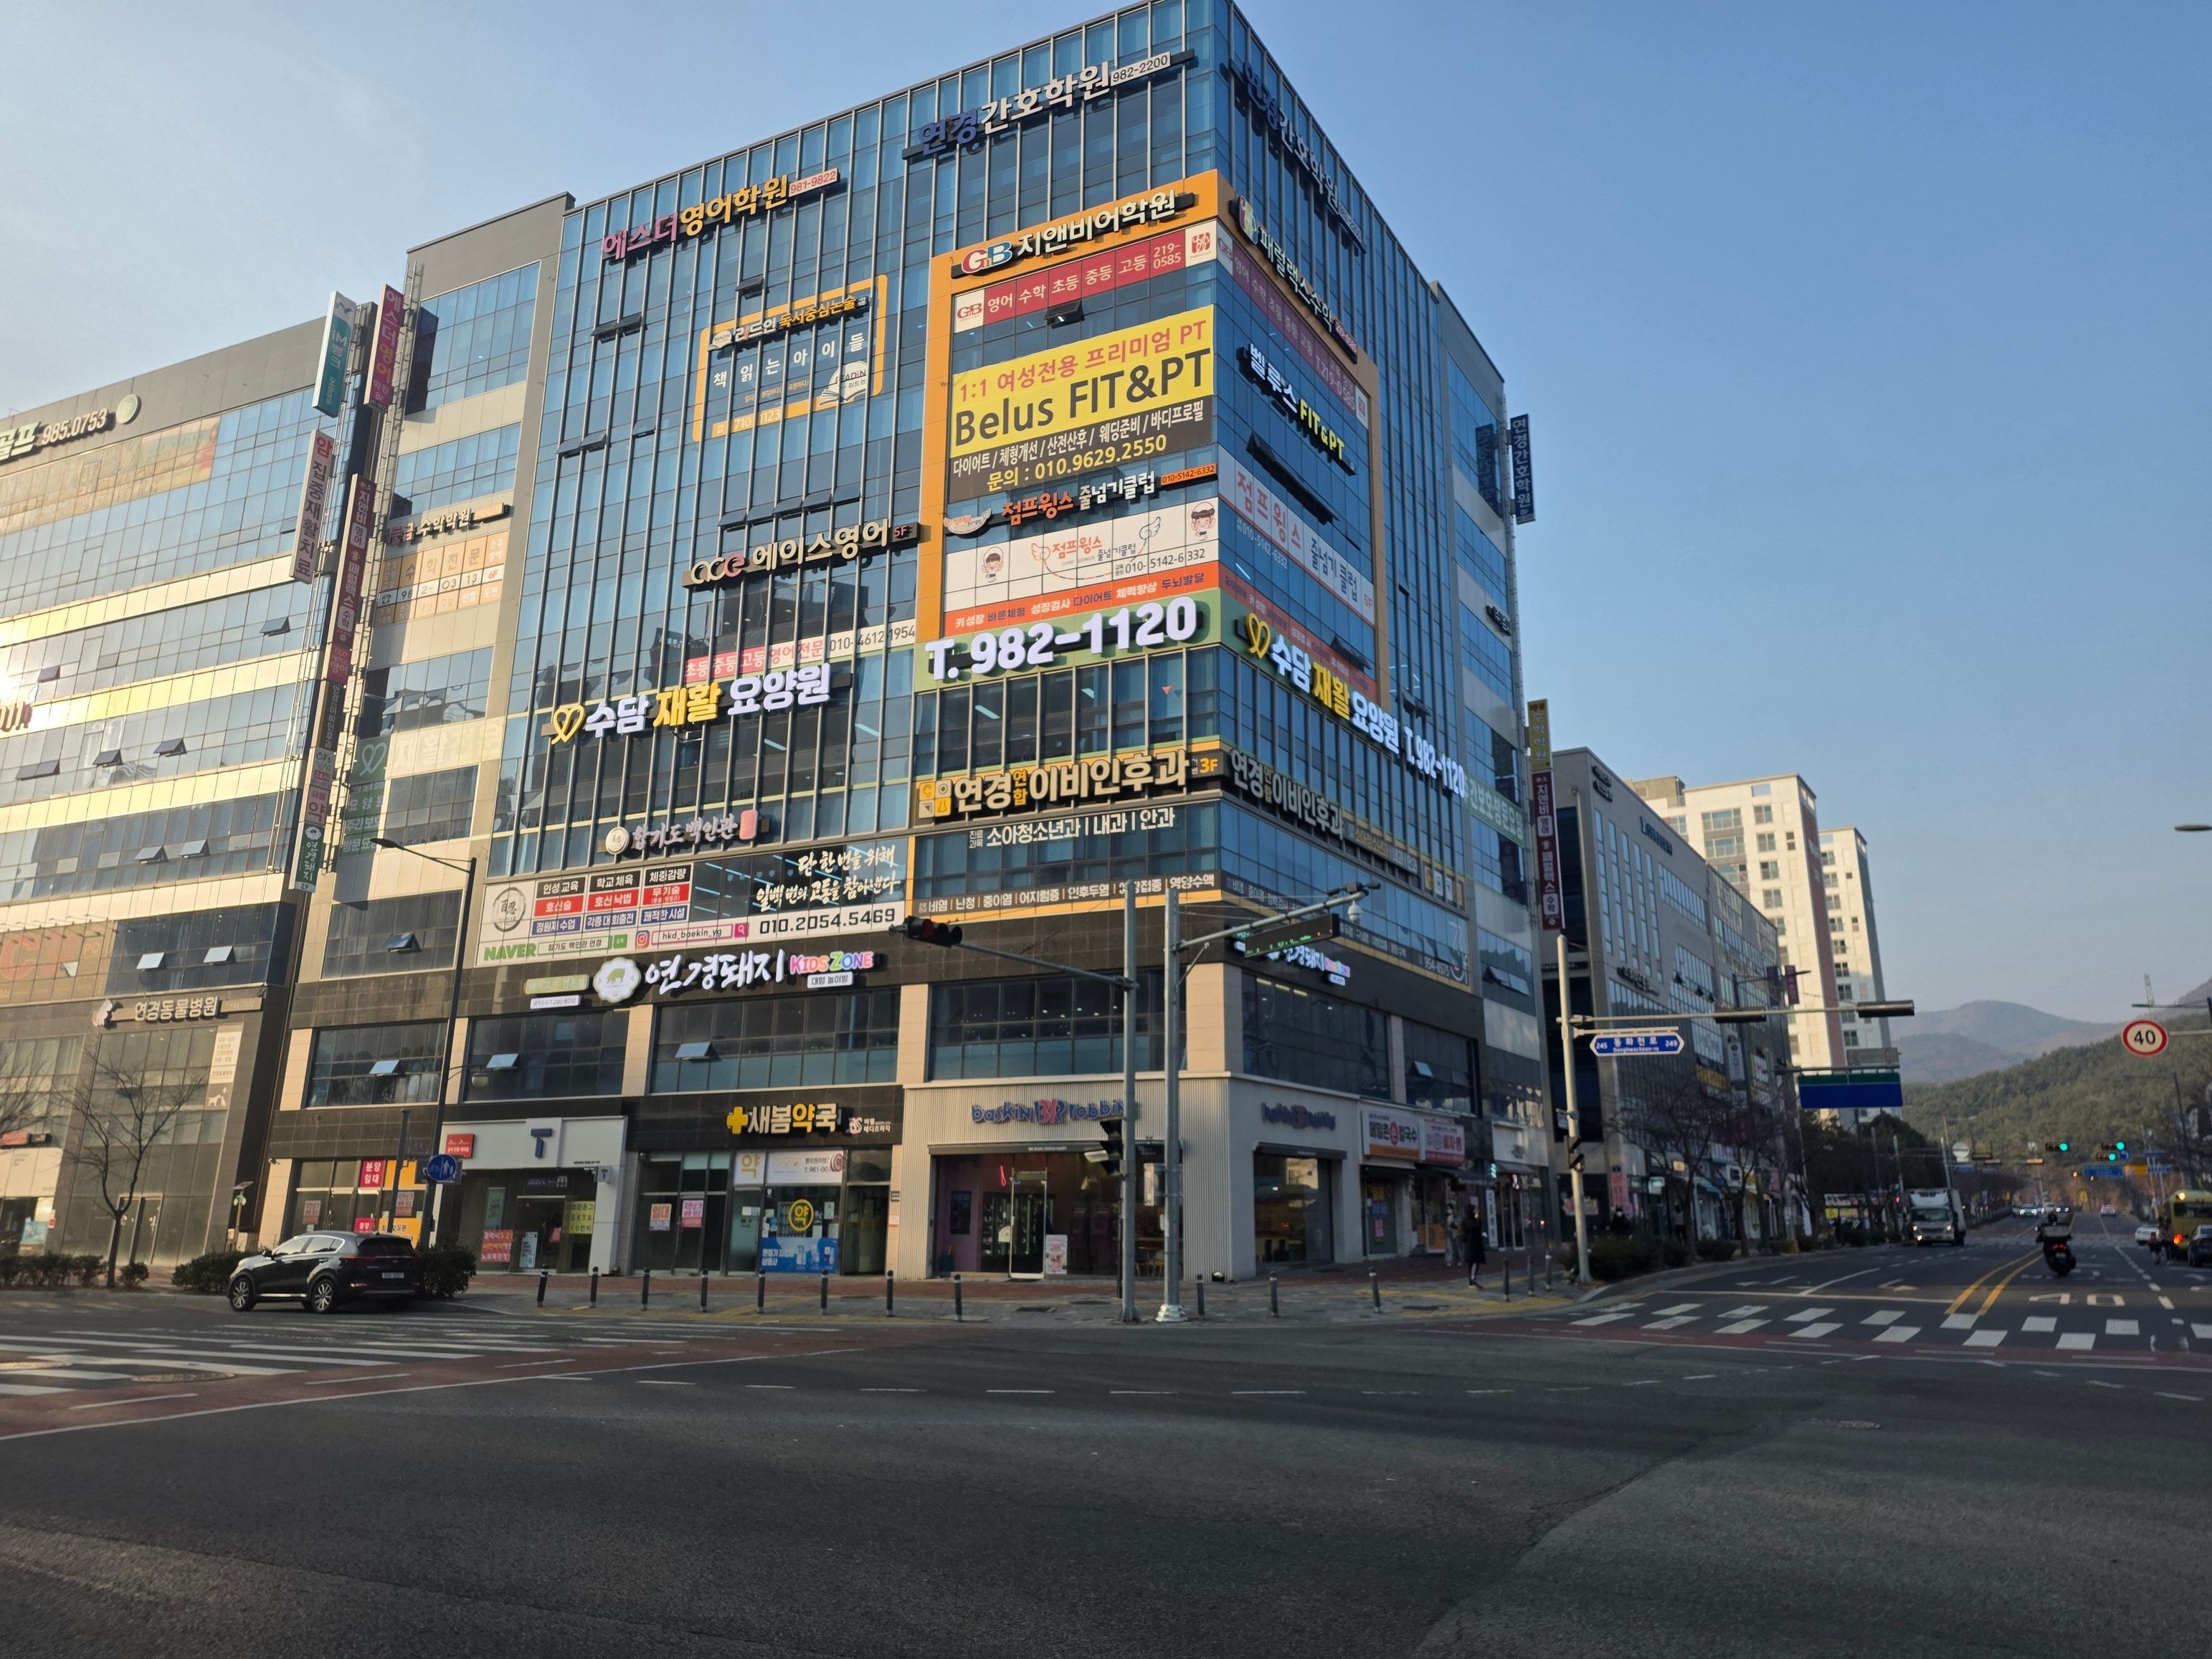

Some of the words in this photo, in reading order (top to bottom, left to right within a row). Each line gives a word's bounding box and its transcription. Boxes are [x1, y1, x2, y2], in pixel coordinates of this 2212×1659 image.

[1113, 54, 1169, 83] 982-2200
[790, 170, 836, 194] 981-9822
[1017, 189, 1176, 257] 지앤비어학원
[987, 292, 1013, 313] 영어
[1018, 285, 1047, 304] 수학
[1051, 275, 1079, 295] 초등
[1085, 265, 1113, 286] 중등
[1119, 254, 1147, 275] 고등
[735, 317, 777, 342] 리드인
[779, 295, 857, 329] 독서중심논술
[1234, 256, 1250, 283] 영어
[1252, 280, 1268, 303] 수학
[1268, 298, 1283, 322] 초등
[1284, 316, 1299, 340] 중등
[1300, 335, 1314, 357] 고등
[959, 379, 987, 402] 1:1
[997, 356, 1079, 393] 여성전용
[1085, 328, 1171, 370] 프리미엄
[1179, 320, 1207, 345] PT
[713, 370, 727, 388] 책
[955, 397, 1055, 447] Belus
[1070, 348, 1211, 419] FIT&PT
[1250, 343, 1298, 414] 벨루스
[1299, 398, 1345, 460] FIT&PT
[42, 407, 108, 446] 985.0753
[953, 454, 991, 477] 다이어트
[1000, 442, 1038, 466] 체형개선
[1047, 430, 1087, 457] 산전산후
[1098, 419, 1141, 444] 웨딩준비
[1150, 400, 1204, 429] 바디프로필
[315, 436, 333, 460] 암
[987, 468, 1019, 492] 문의
[1035, 434, 1167, 480] 010.9629.2550
[1512, 417, 1532, 509] 연경간호학원
[1002, 493, 1075, 526] 점프윙스
[1078, 470, 1156, 510] 줄넘기클럽
[1162, 465, 1215, 484] 010-5142-6332
[420, 506, 471, 537] 수학학원
[1237, 470, 1301, 550] 점프윙스
[1311, 537, 1359, 603] 줄넘기클럽
[751, 518, 890, 572] 에이스영어
[893, 526, 908, 538] 5F
[1052, 536, 1103, 560] 점프윙스
[1097, 543, 1136, 562] 줄넘기클럽
[1124, 548, 1206, 574] 010-5142-6332
[987, 606, 1026, 622] 바른체형
[1030, 598, 1071, 615] 성장검사
[1073, 590, 1113, 607] 다이어트
[1116, 582, 1157, 599] 체력향상
[1161, 572, 1205, 590] 두뇌발달
[684, 655, 708, 678] 초등
[712, 650, 736, 673] 중등
[740, 647, 764, 669] 고등
[830, 624, 916, 652] 010-4612-1954
[584, 695, 650, 738] 수담
[653, 682, 723, 728] 재활
[727, 662, 832, 716] 요양원
[1271, 634, 1312, 693] 수담
[1312, 662, 1351, 721] 재활
[1350, 690, 1400, 756] 요양원
[954, 773, 1012, 813] 연경
[1029, 749, 1190, 802] 이비인후과
[1199, 757, 1218, 774] 3F
[1230, 749, 1264, 799] 연경
[1272, 772, 1344, 841] 이비인후과
[308, 802, 326, 823] 약
[986, 817, 1081, 848] 소아청소년과
[1093, 813, 1128, 836] 내과
[1139, 807, 1176, 830] 안과
[632, 822, 685, 850] 합기도
[685, 813, 739, 845] 백인관
[798, 851, 817, 876] 단
[819, 850, 835, 873] 한
[837, 850, 863, 871] 번을
[863, 845, 896, 867] 위해
[545, 900, 572, 913] 호신술
[756, 883, 785, 912] 일백
[785, 884, 808, 905] 번의
[810, 878, 840, 905] 고통을
[842, 870, 901, 900] 참아낸다
[929, 899, 948, 913] 비염
[955, 897, 975, 911] 난청
[983, 893, 1012, 907] 중이염
[1019, 888, 1060, 903] 어지럼증
[1067, 883, 1110, 900] 인후두염
[1169, 873, 1215, 890] 영양수액
[559, 918, 576, 931] 수업
[643, 909, 668, 922] 쾌적한
[669, 907, 686, 919] 시설
[759, 908, 896, 934] 010.2054.5469
[662, 928, 723, 942] hkd_baekin_yg
[483, 943, 537, 961] NAVER
[790, 954, 830, 975] KIDS
[830, 951, 874, 971] ZONE
[645, 949, 785, 995] 연경돼지
[134, 994, 219, 1022] 연경동물병원
[2133, 1029, 2156, 1046] 40
[747, 1102, 839, 1135] 새봄약국
[972, 1101, 1030, 1123] baskin
[1068, 1099, 1126, 1120] robbin
[531, 1128, 553, 1159] T
[364, 1174, 380, 1184] 임대
[366, 1161, 381, 1171] 분양
[740, 1152, 761, 1179] 약
[794, 1204, 810, 1226] 약
